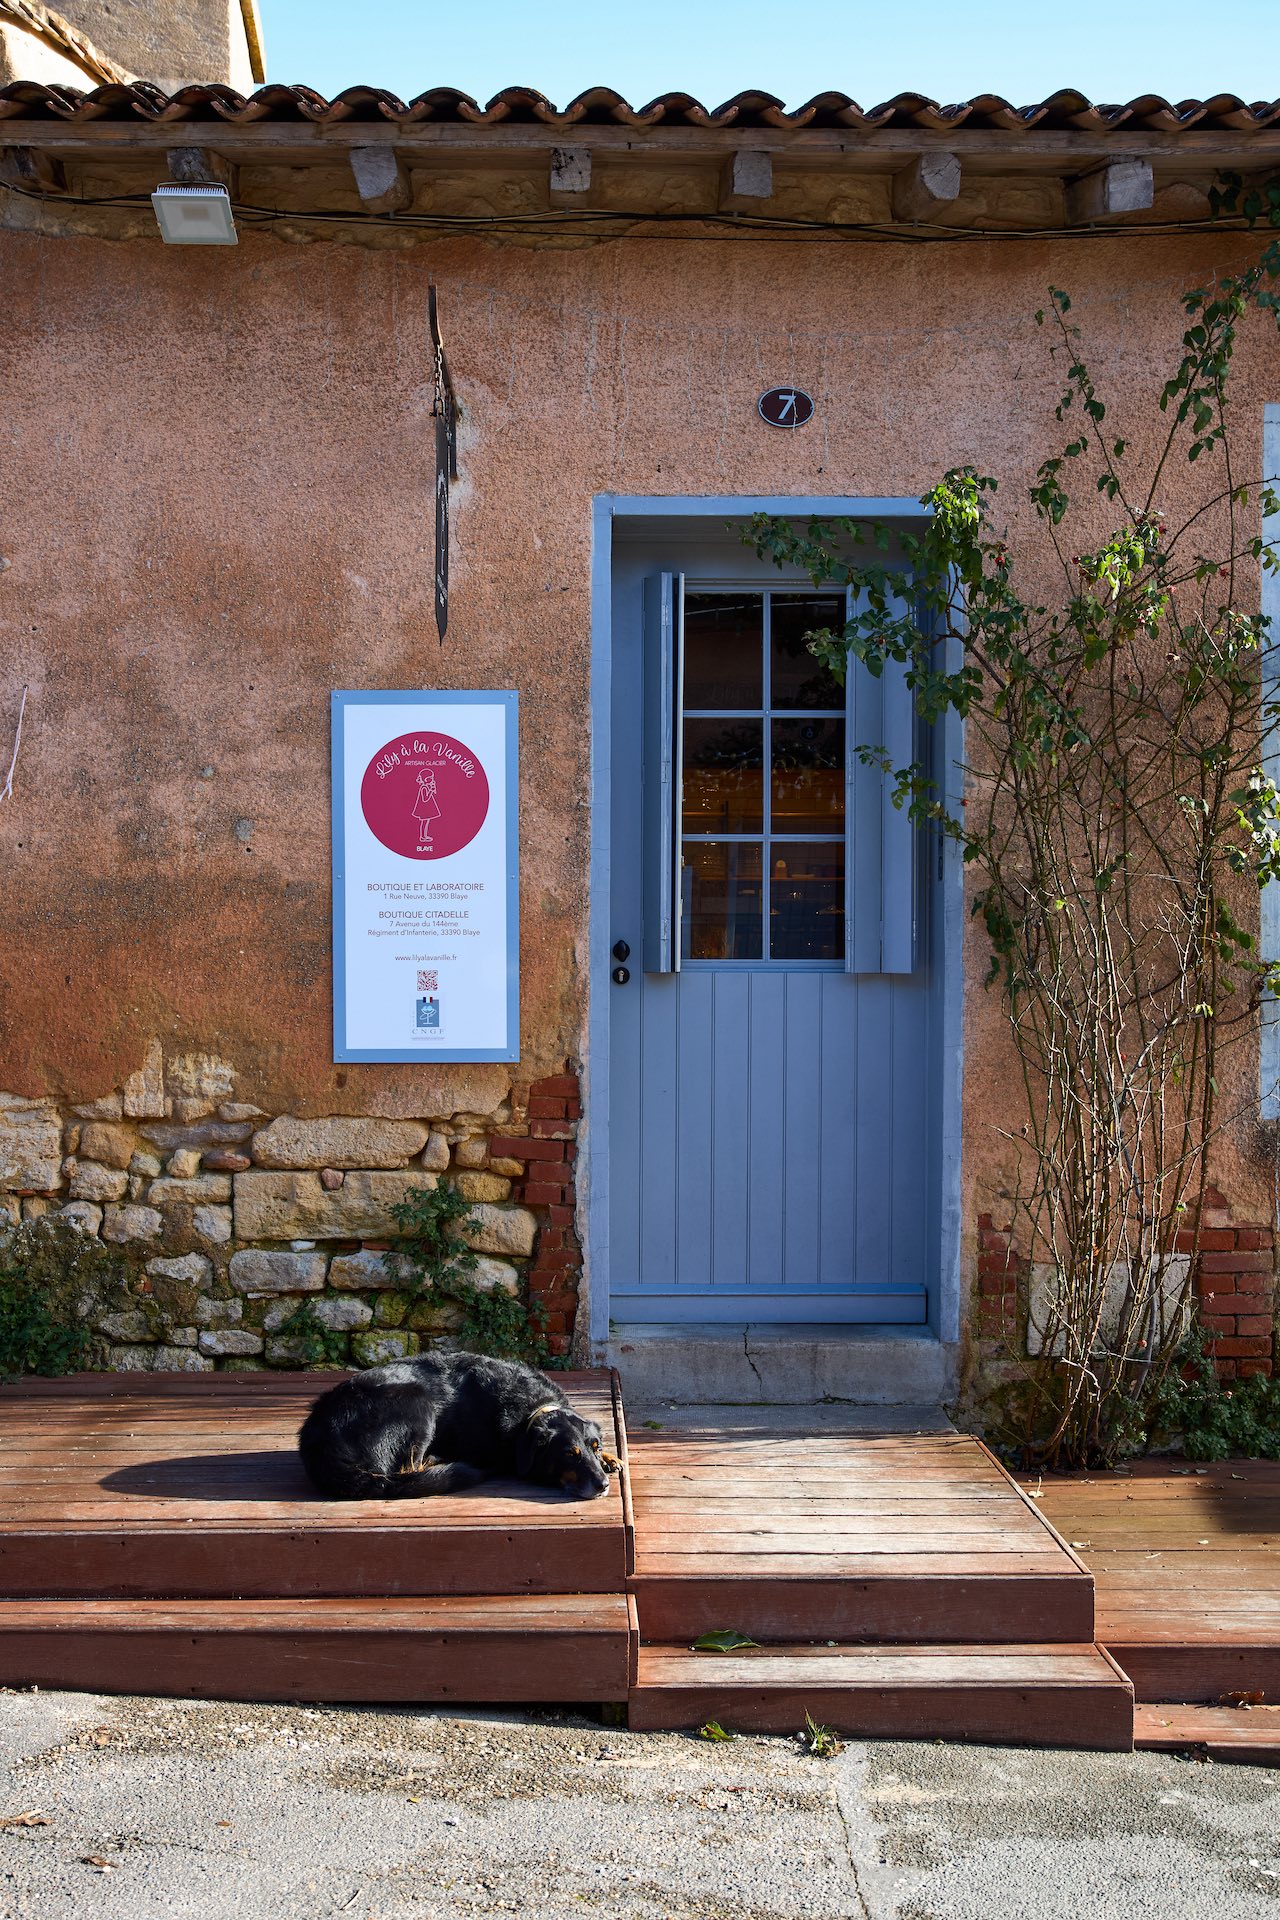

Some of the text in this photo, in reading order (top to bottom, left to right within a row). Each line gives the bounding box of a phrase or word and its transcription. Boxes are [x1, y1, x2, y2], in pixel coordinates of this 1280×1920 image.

[778, 394, 797, 419] 7
[376, 739, 476, 780] Lily à la Vanille
[367, 883, 485, 891] BOUTIQUE ET LABORATOIRE
[403, 893, 427, 901] Neuve,
[428, 892, 449, 900] 33390
[450, 892, 469, 901] Blaye
[378, 910, 469, 919] BOUTIQUE CITADELLE
[367, 929, 399, 938] Régiment
[440, 928, 461, 936] 33390
[462, 928, 481, 937] Blaye
